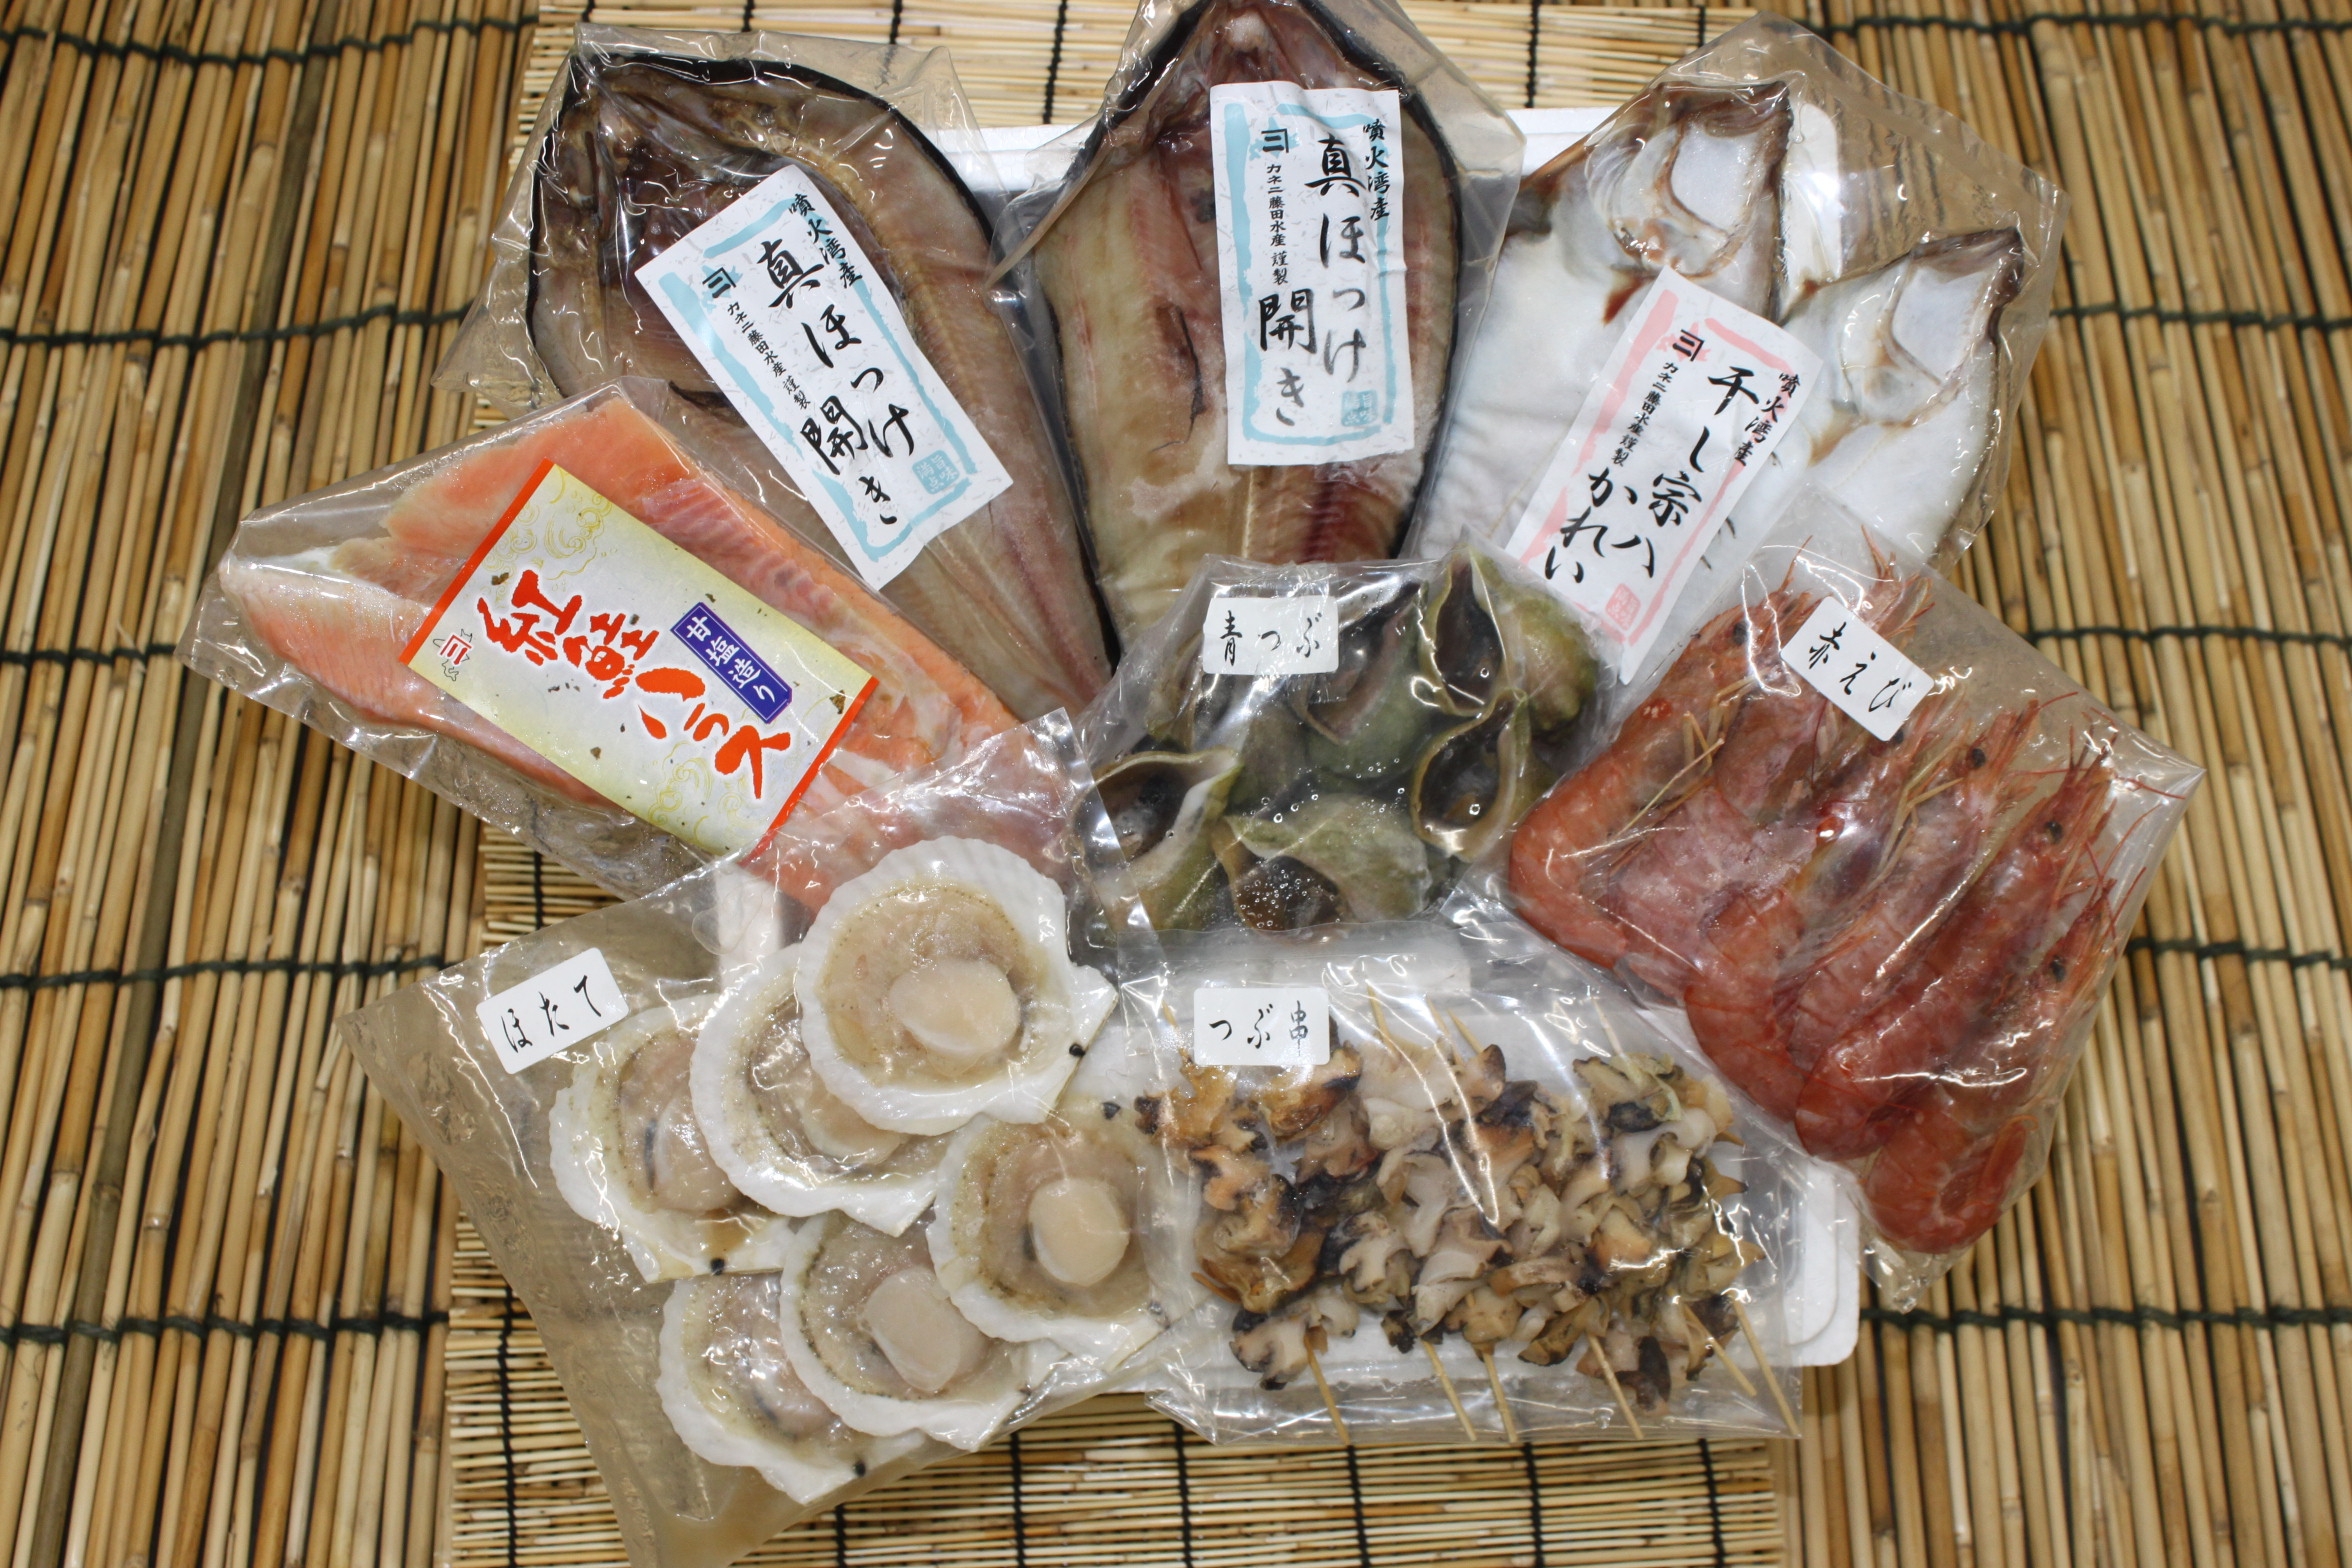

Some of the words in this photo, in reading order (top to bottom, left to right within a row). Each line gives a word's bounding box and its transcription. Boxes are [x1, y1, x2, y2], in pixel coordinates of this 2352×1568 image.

[1363, 119, 1391, 221] 噴火湾産
[788, 193, 864, 290] 噴火湾産
[1305, 135, 1369, 384] 真ほっけ
[756, 238, 914, 457] 真ほっけ
[1259, 287, 1318, 427] 開き
[799, 395, 898, 526] 開き
[1733, 372, 1801, 467] 噴火湾産
[1611, 366, 1761, 579] 干し宗八
[1545, 466, 1639, 584] かれい
[477, 569, 792, 800] 紅鮭ハラス
[685, 615, 776, 703] 甘塩造り
[1219, 610, 1323, 666] 青つぶ
[1808, 621, 1913, 713] 赤えび
[500, 974, 602, 1053] ほたて
[1208, 1000, 1309, 1057] つぶ串
